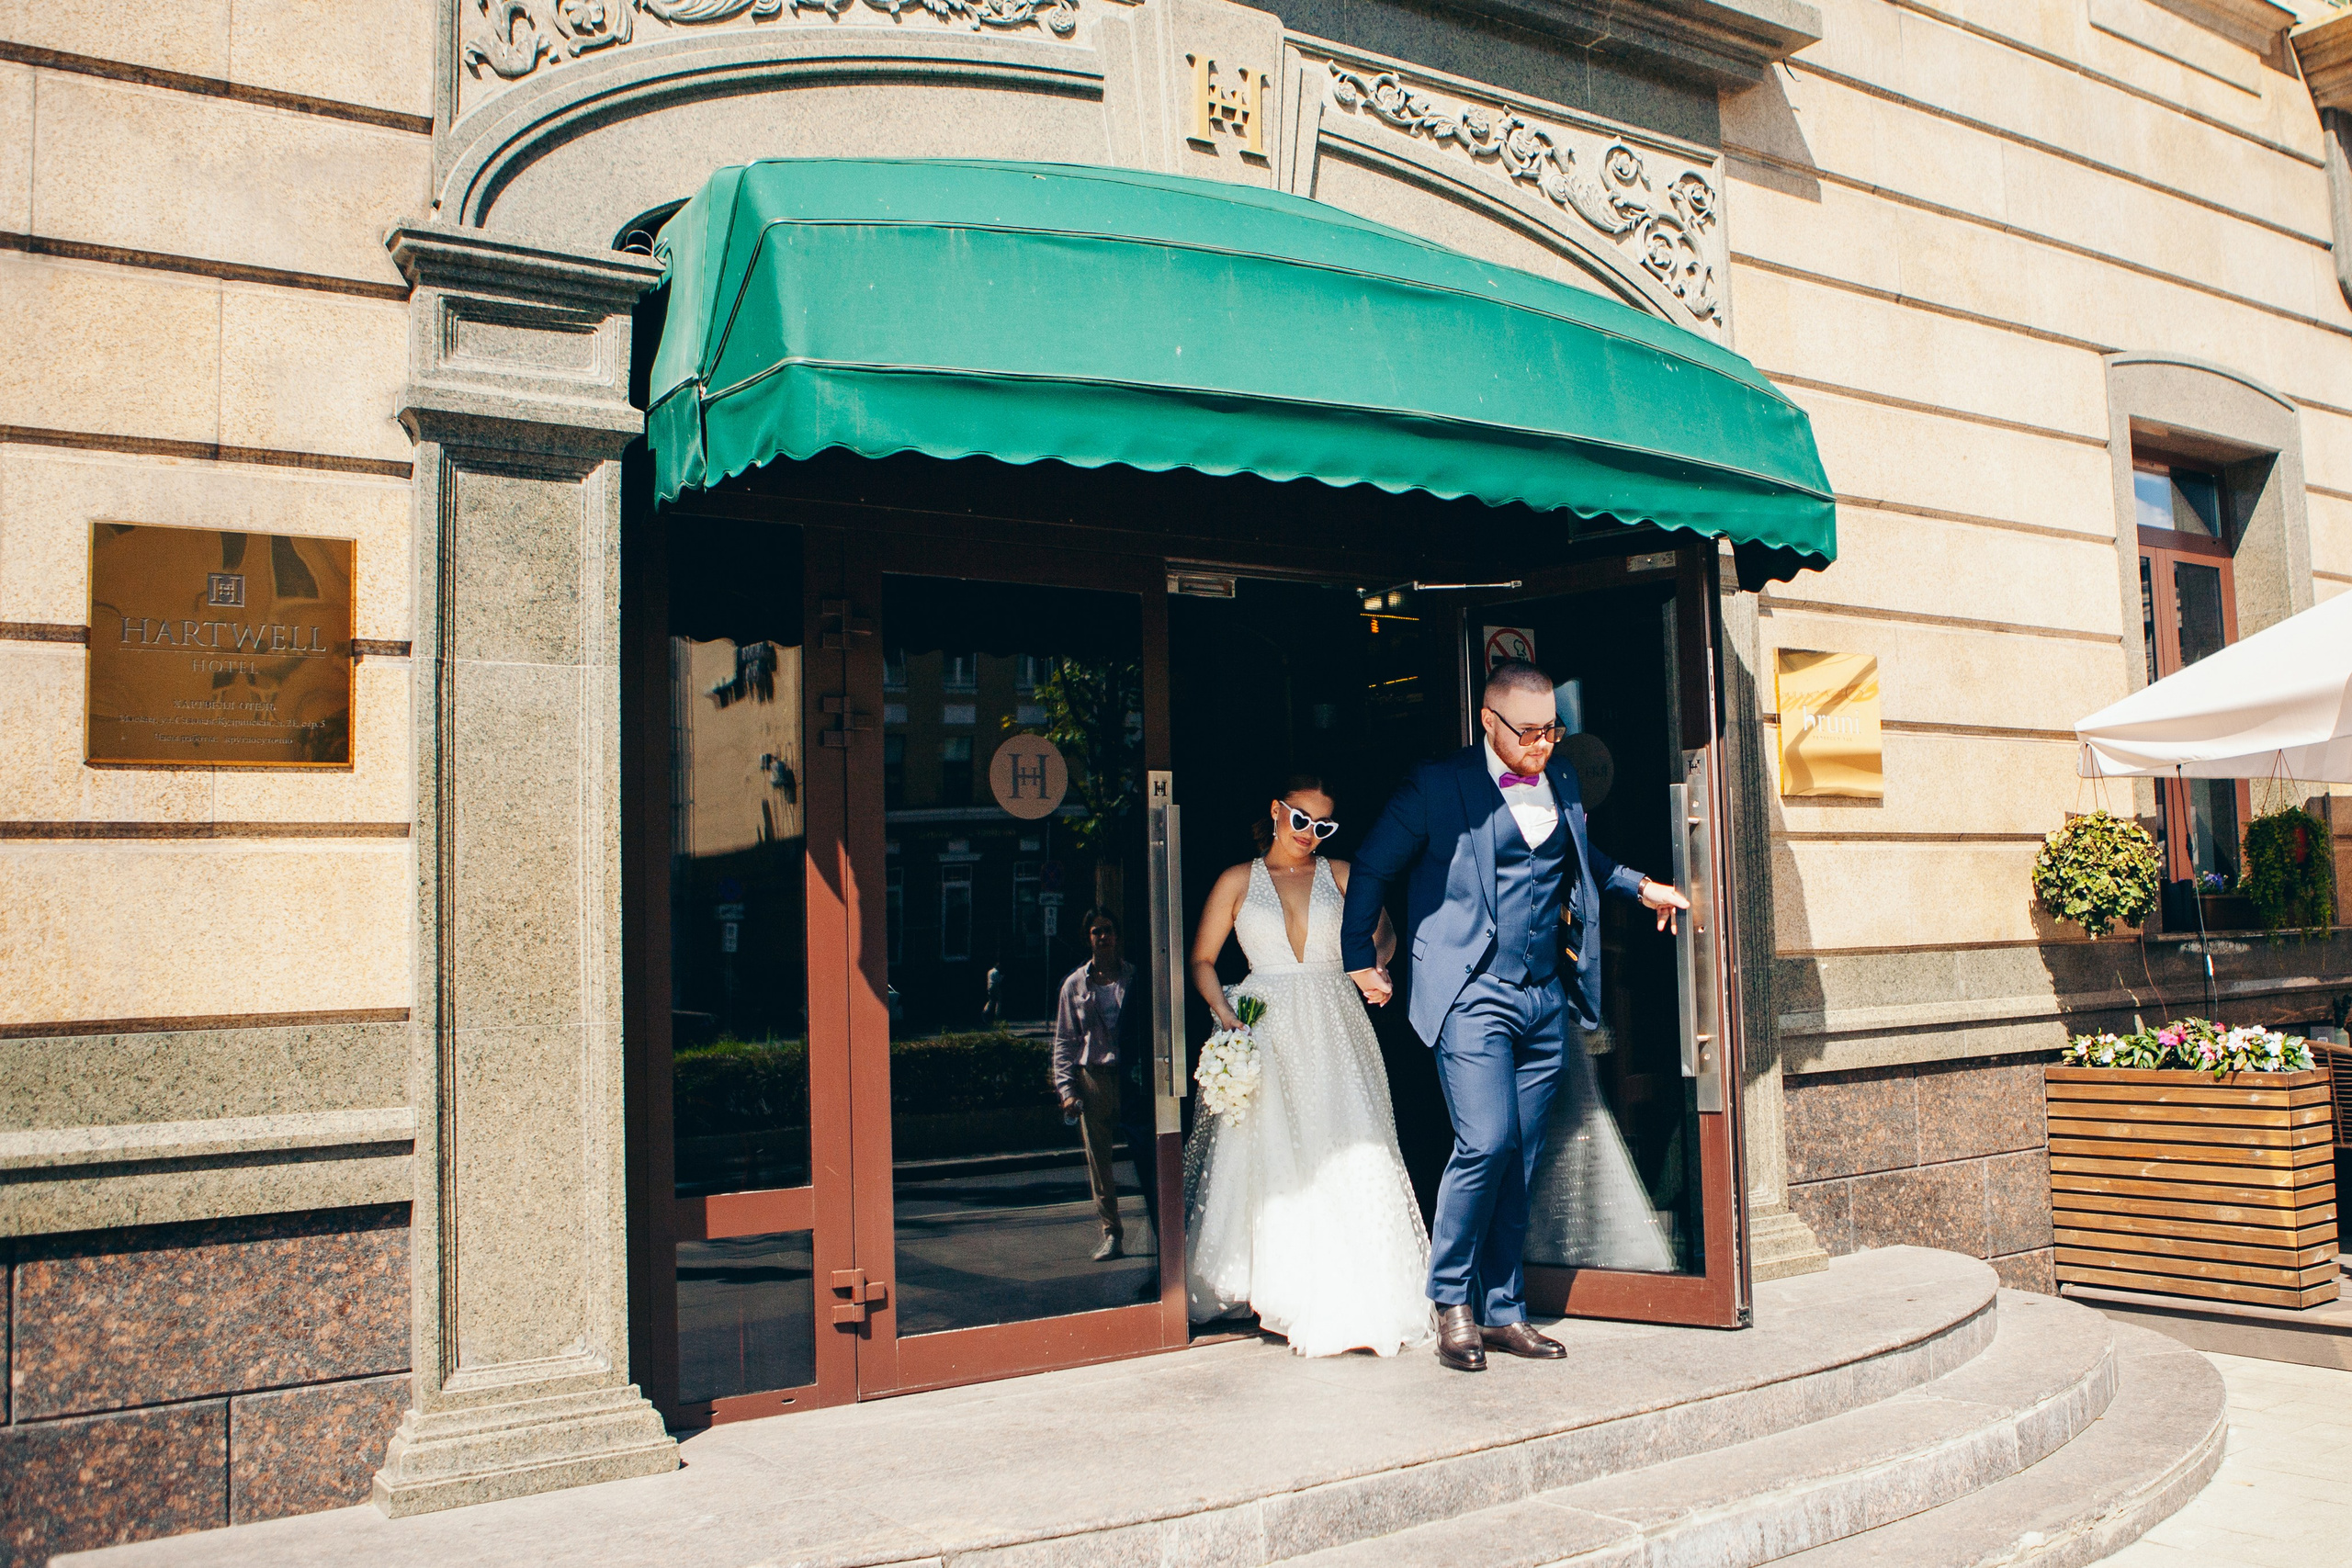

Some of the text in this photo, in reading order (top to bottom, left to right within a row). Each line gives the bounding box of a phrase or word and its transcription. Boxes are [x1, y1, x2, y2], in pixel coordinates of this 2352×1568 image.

[121, 616, 327, 652] HARTWELL
[192, 659, 259, 674] HOTEL
[239, 701, 276, 711] ОТЕЛЬ
[1802, 704, 1861, 735] bruni
